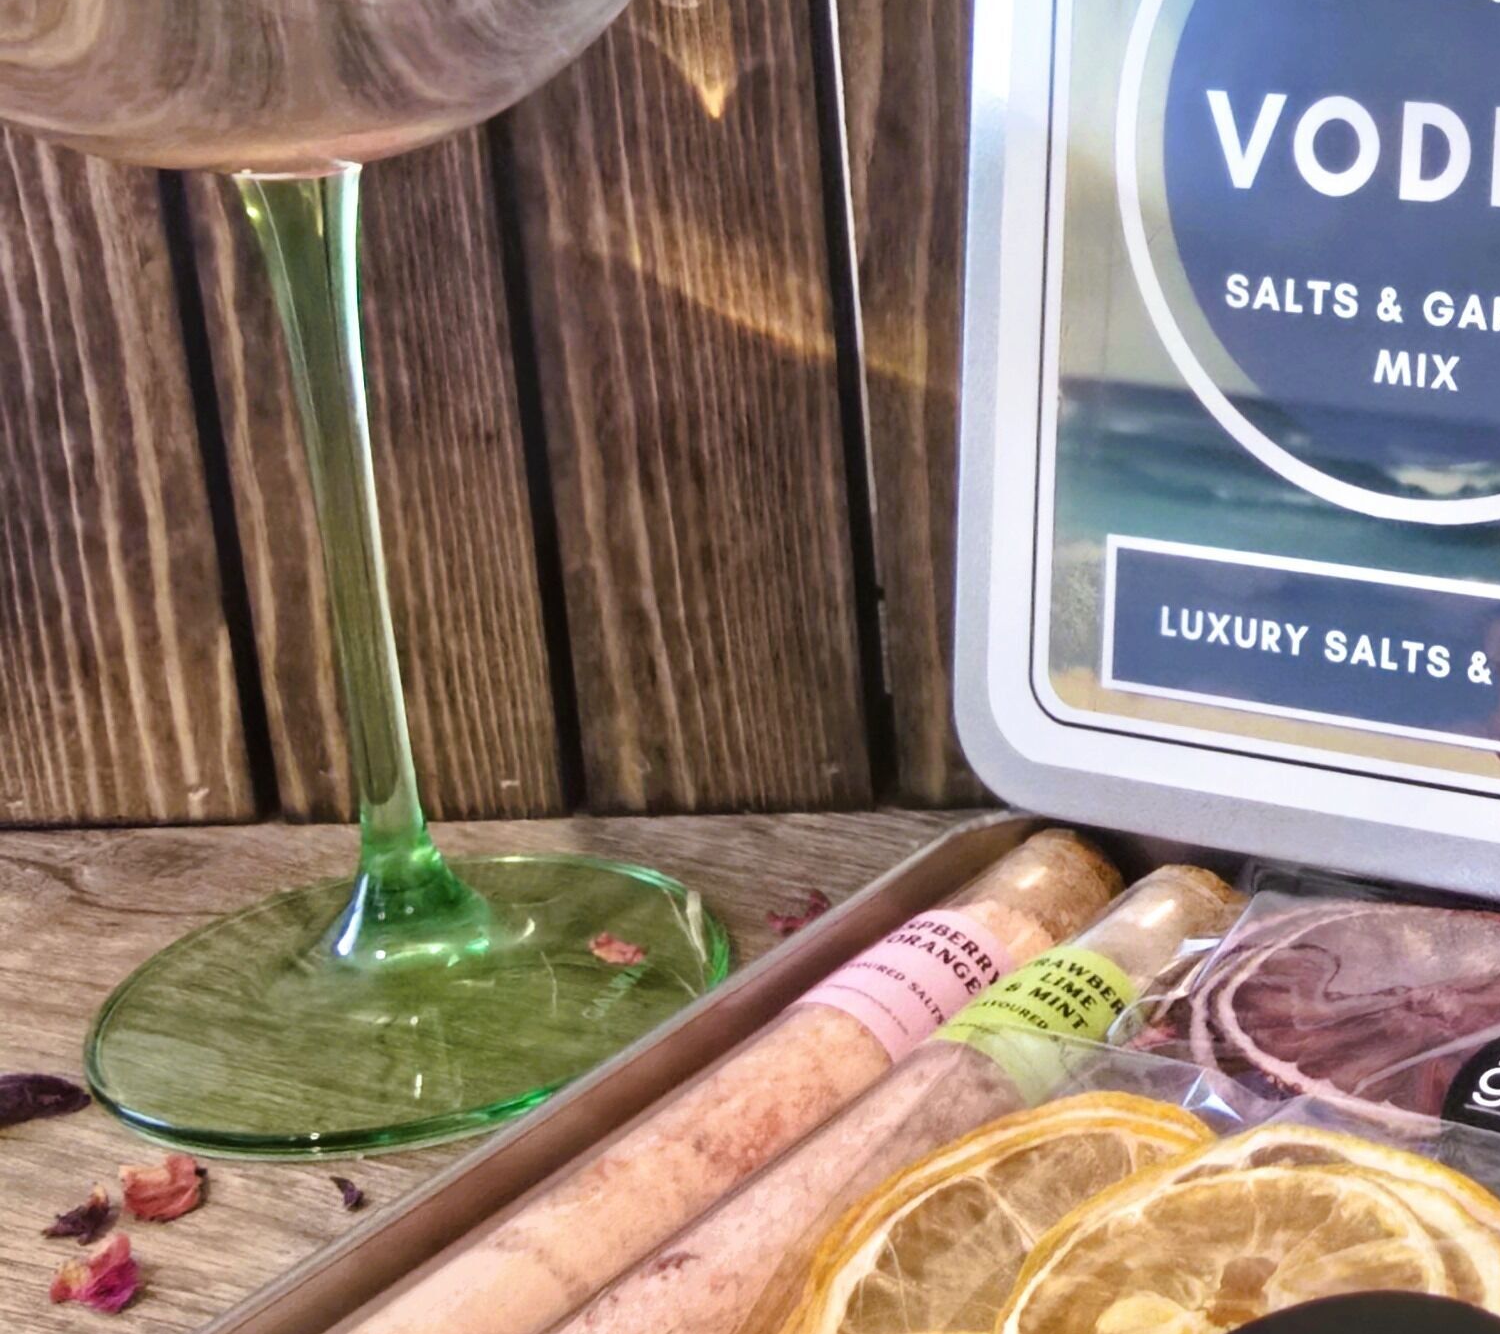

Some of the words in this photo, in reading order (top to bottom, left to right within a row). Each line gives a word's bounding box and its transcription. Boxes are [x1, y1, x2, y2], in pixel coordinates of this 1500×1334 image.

[1225, 273, 1359, 319] SALTS
[1376, 287, 1403, 323] &
[1372, 349, 1460, 392] MIX
[1160, 605, 1309, 657] LUXURY
[1323, 630, 1451, 679] SALTS
[1466, 651, 1493, 685] &
[1027, 986, 1089, 1031] MINT
[1040, 972, 1098, 1011] LIME
